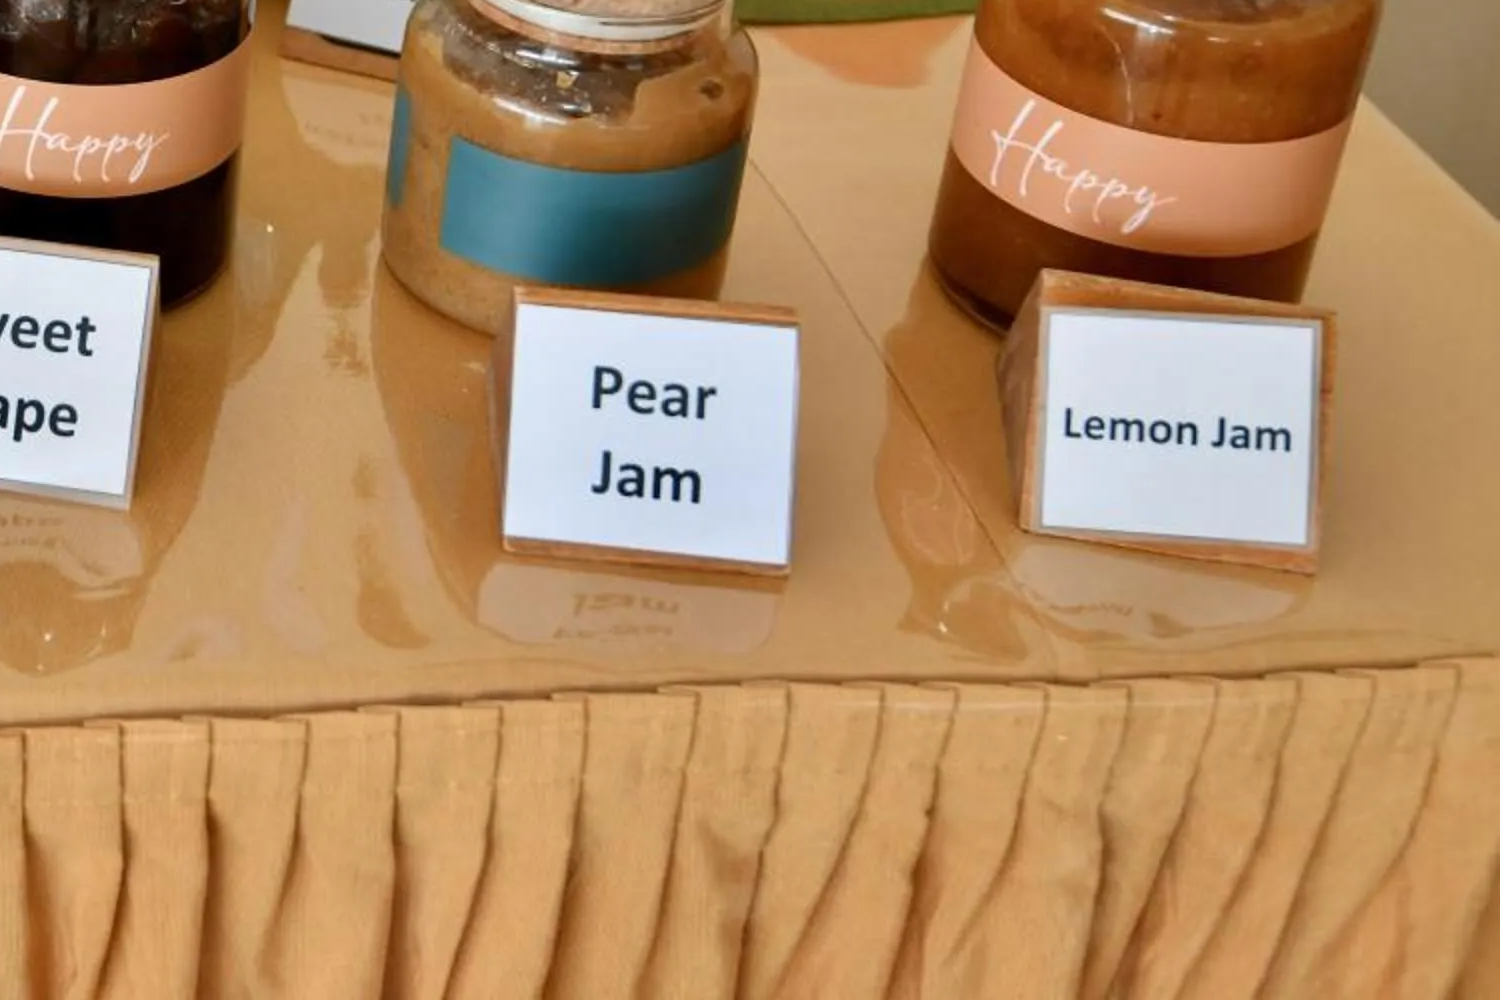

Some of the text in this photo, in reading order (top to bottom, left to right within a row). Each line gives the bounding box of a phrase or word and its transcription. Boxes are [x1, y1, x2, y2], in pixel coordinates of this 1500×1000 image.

[990, 99, 1177, 234] Happy
[591, 365, 717, 420] Pear
[1064, 407, 1292, 453] Lemon Jam
[590, 449, 701, 504] Jam
